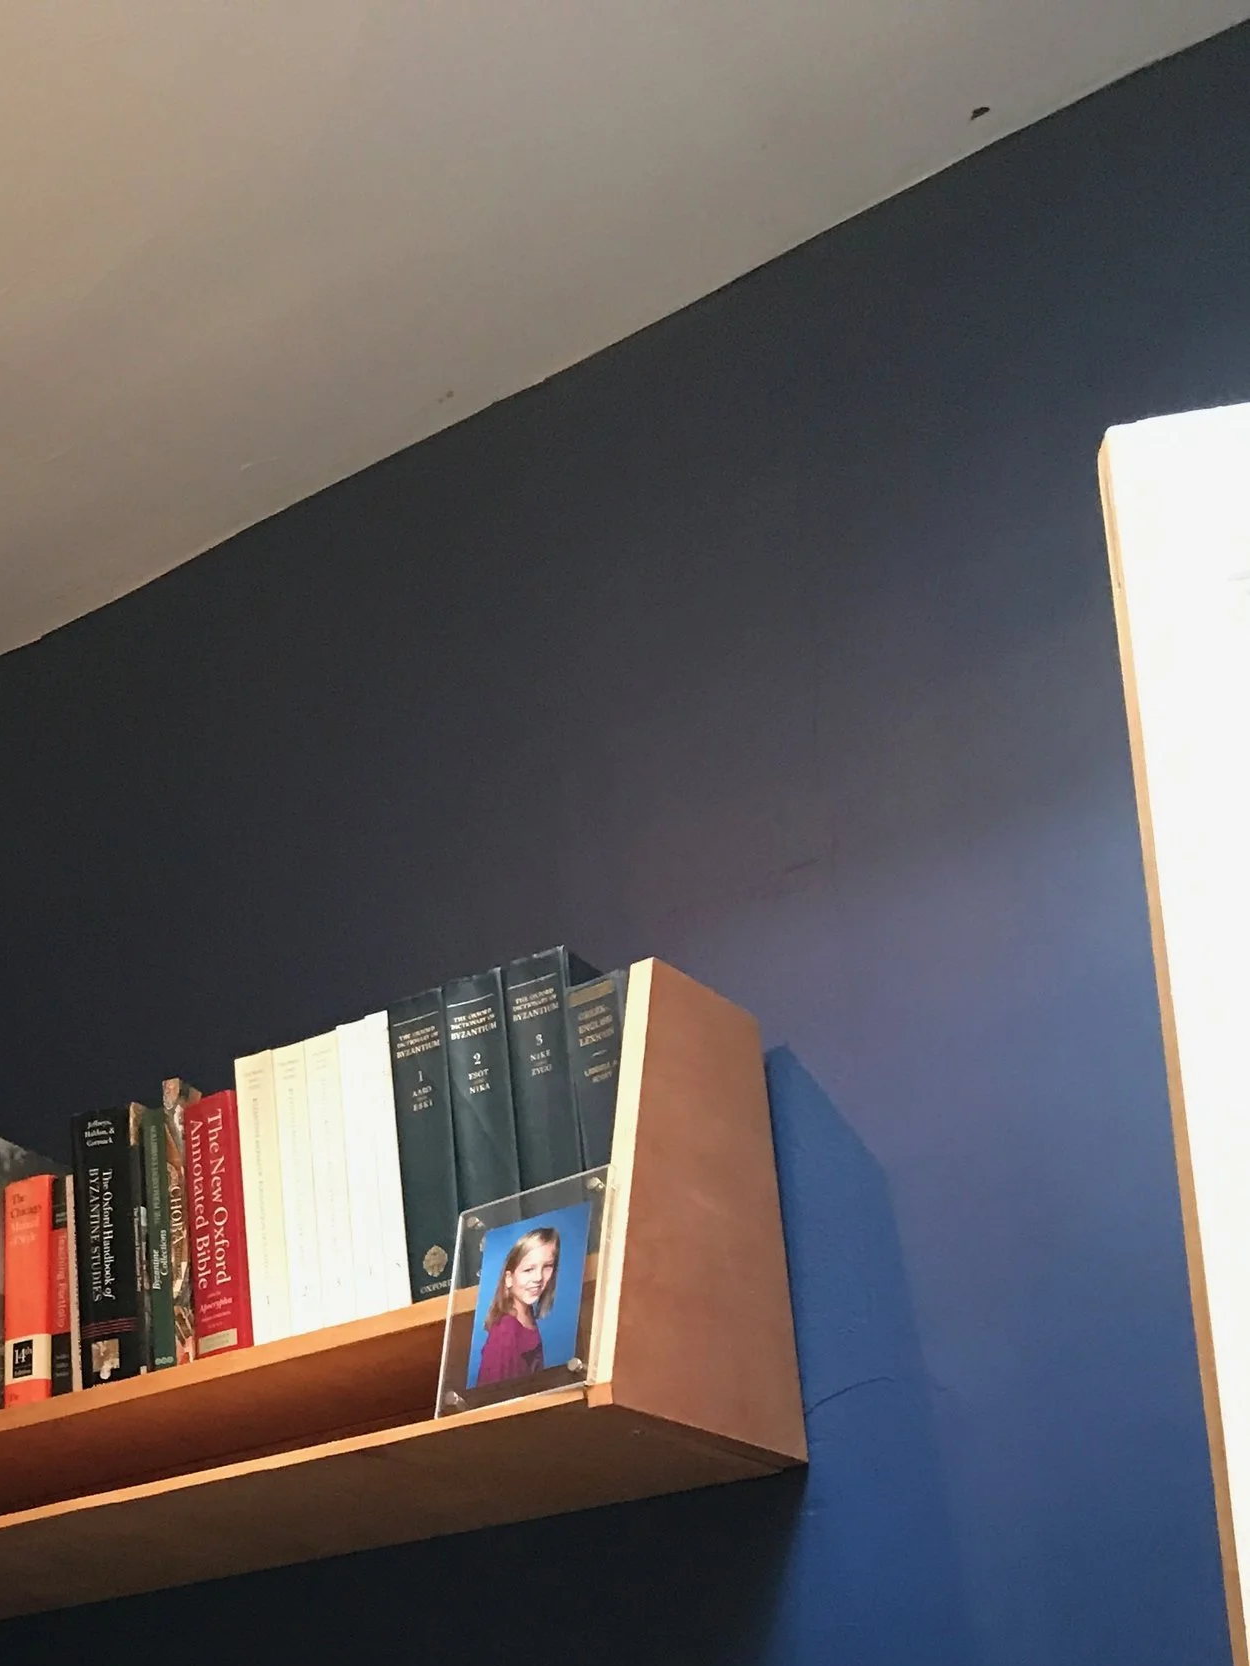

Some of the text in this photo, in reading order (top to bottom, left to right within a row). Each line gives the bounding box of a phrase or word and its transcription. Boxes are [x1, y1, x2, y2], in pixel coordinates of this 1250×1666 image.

[450, 1021, 497, 1041] BYZANTIUM
[512, 1002, 559, 1022] BYZANTIUM
[396, 1039, 441, 1059] BYZANTIUM
[473, 1052, 482, 1065] 2
[535, 1033, 543, 1046] 3
[469, 1082, 491, 1095] NIKA
[207, 1108, 222, 1151] The
[210, 1155, 226, 1204] New
[170, 1186, 184, 1245] CHORA
[189, 1120, 212, 1290] Annotated Bible
[88, 1168, 103, 1302] BYZANTINE STUDIES
[102, 1168, 116, 1300] The Oxford Handbook of
[213, 1206, 232, 1285] Oxford
[152, 1229, 168, 1290] Byzantine Collections
[14, 1347, 32, 1365] 14th
